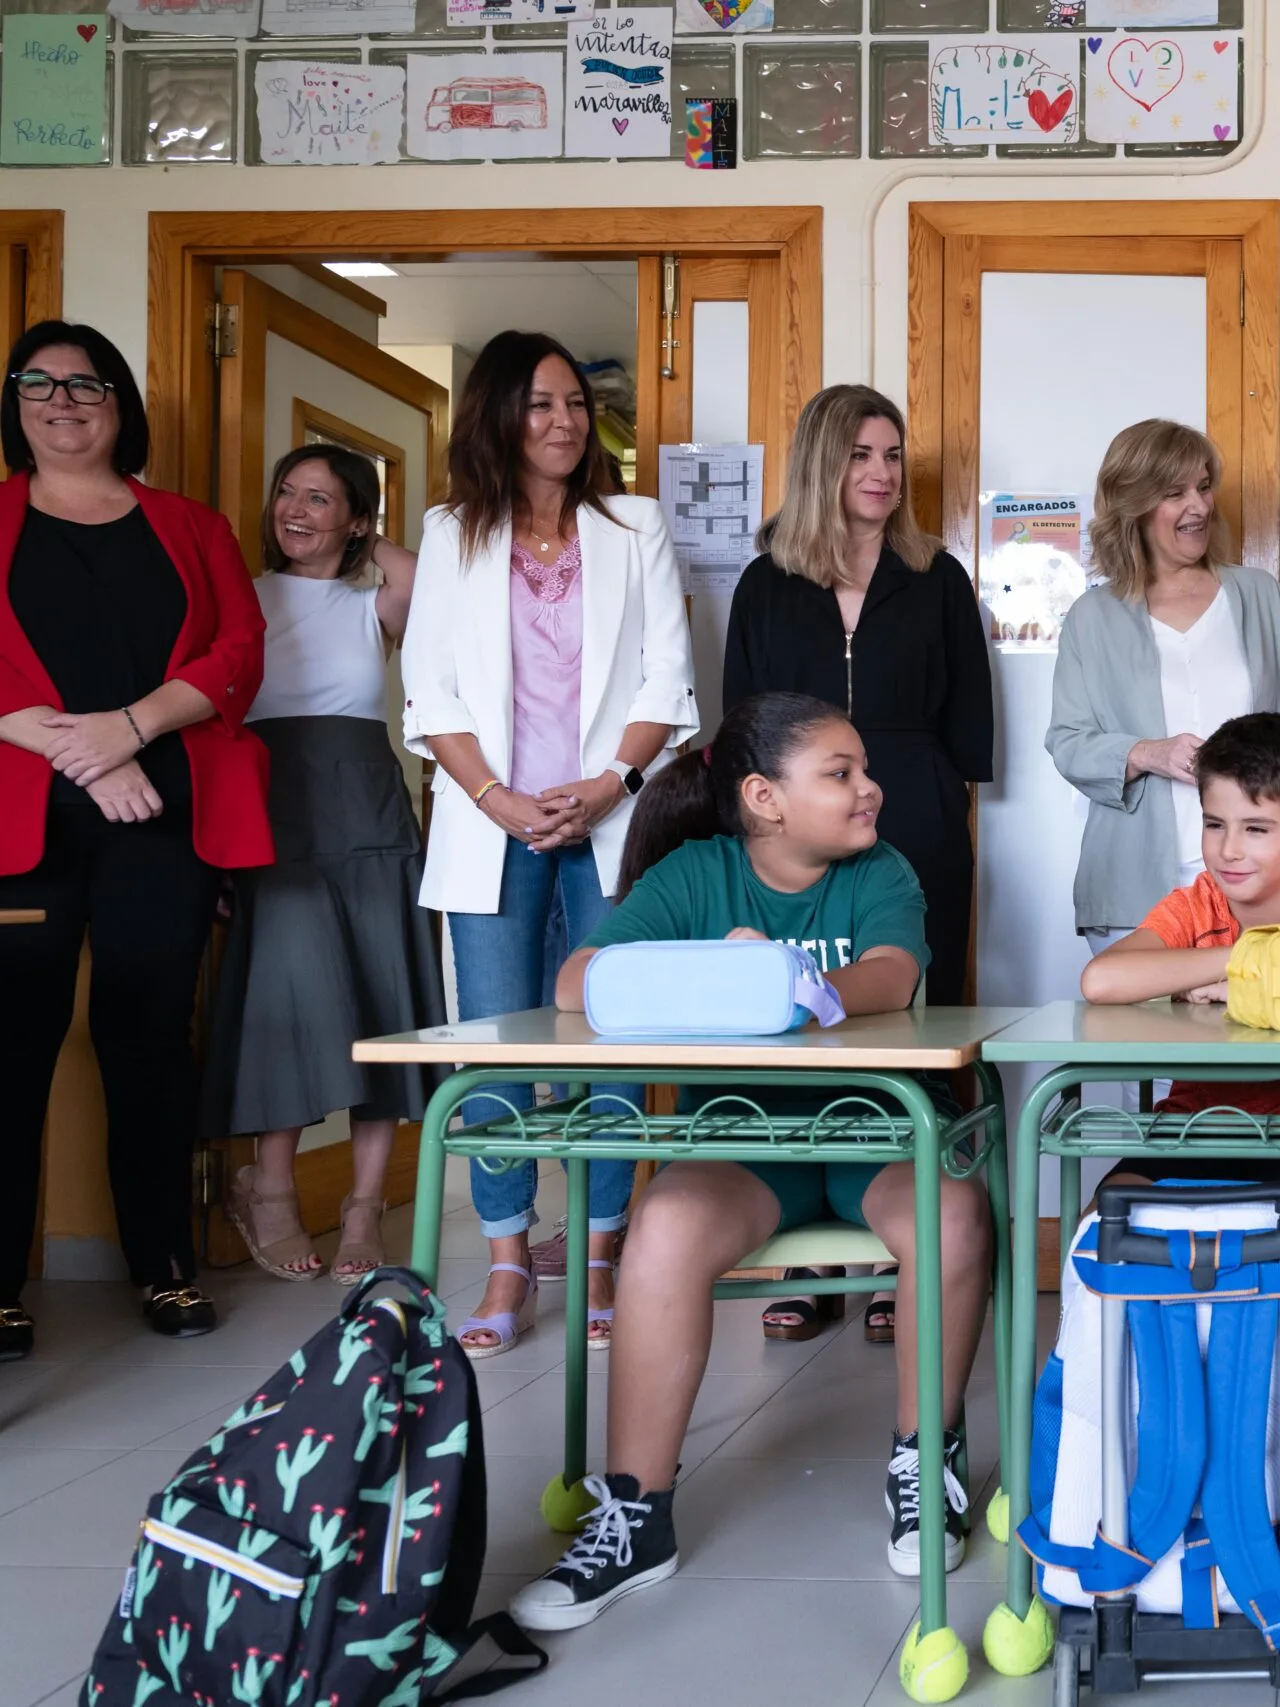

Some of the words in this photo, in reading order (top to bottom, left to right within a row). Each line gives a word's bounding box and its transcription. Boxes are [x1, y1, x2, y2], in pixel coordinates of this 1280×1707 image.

[13, 118, 95, 149] Perfecto
[277, 99, 368, 139] Maite
[996, 501, 1076, 513] ENCARGADOS
